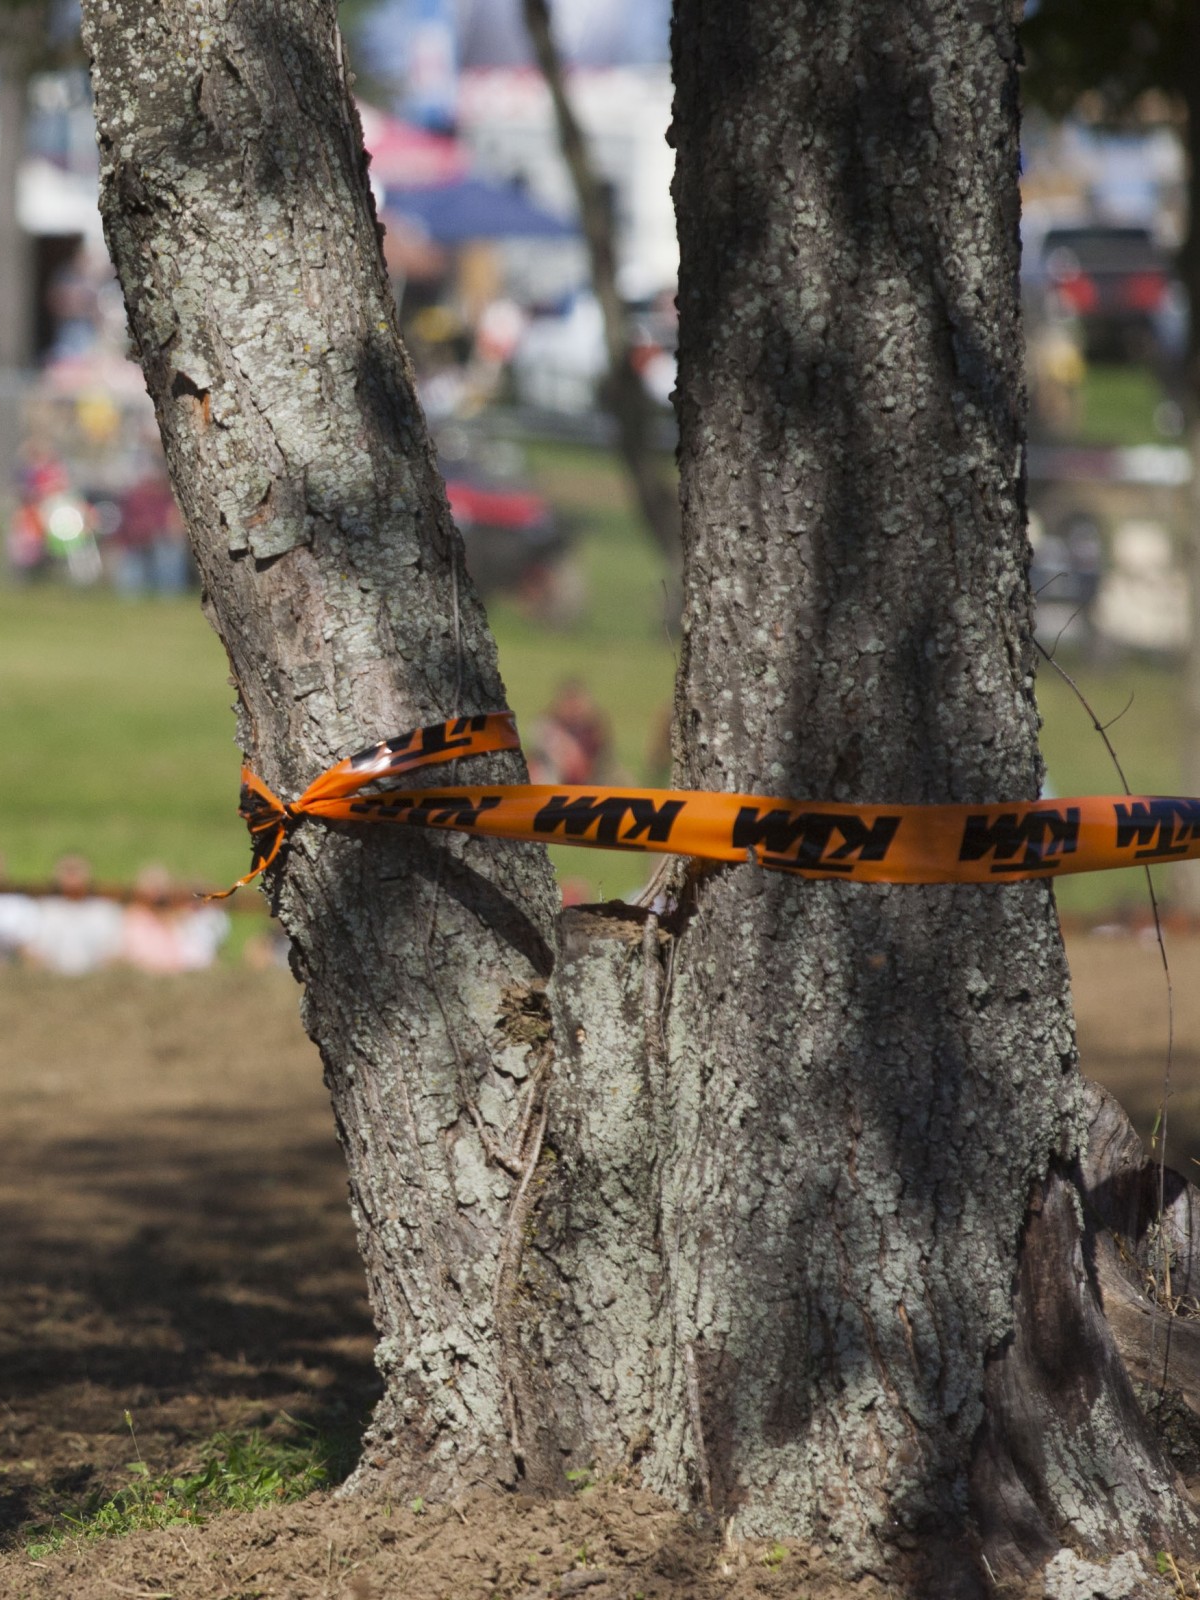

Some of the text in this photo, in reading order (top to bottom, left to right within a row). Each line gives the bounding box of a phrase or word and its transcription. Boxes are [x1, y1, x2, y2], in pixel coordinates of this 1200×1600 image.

[533, 796, 686, 850] KTM
[732, 806, 903, 872] KTM
[959, 807, 1081, 873] KTM
[1113, 800, 1200, 859] KTM
